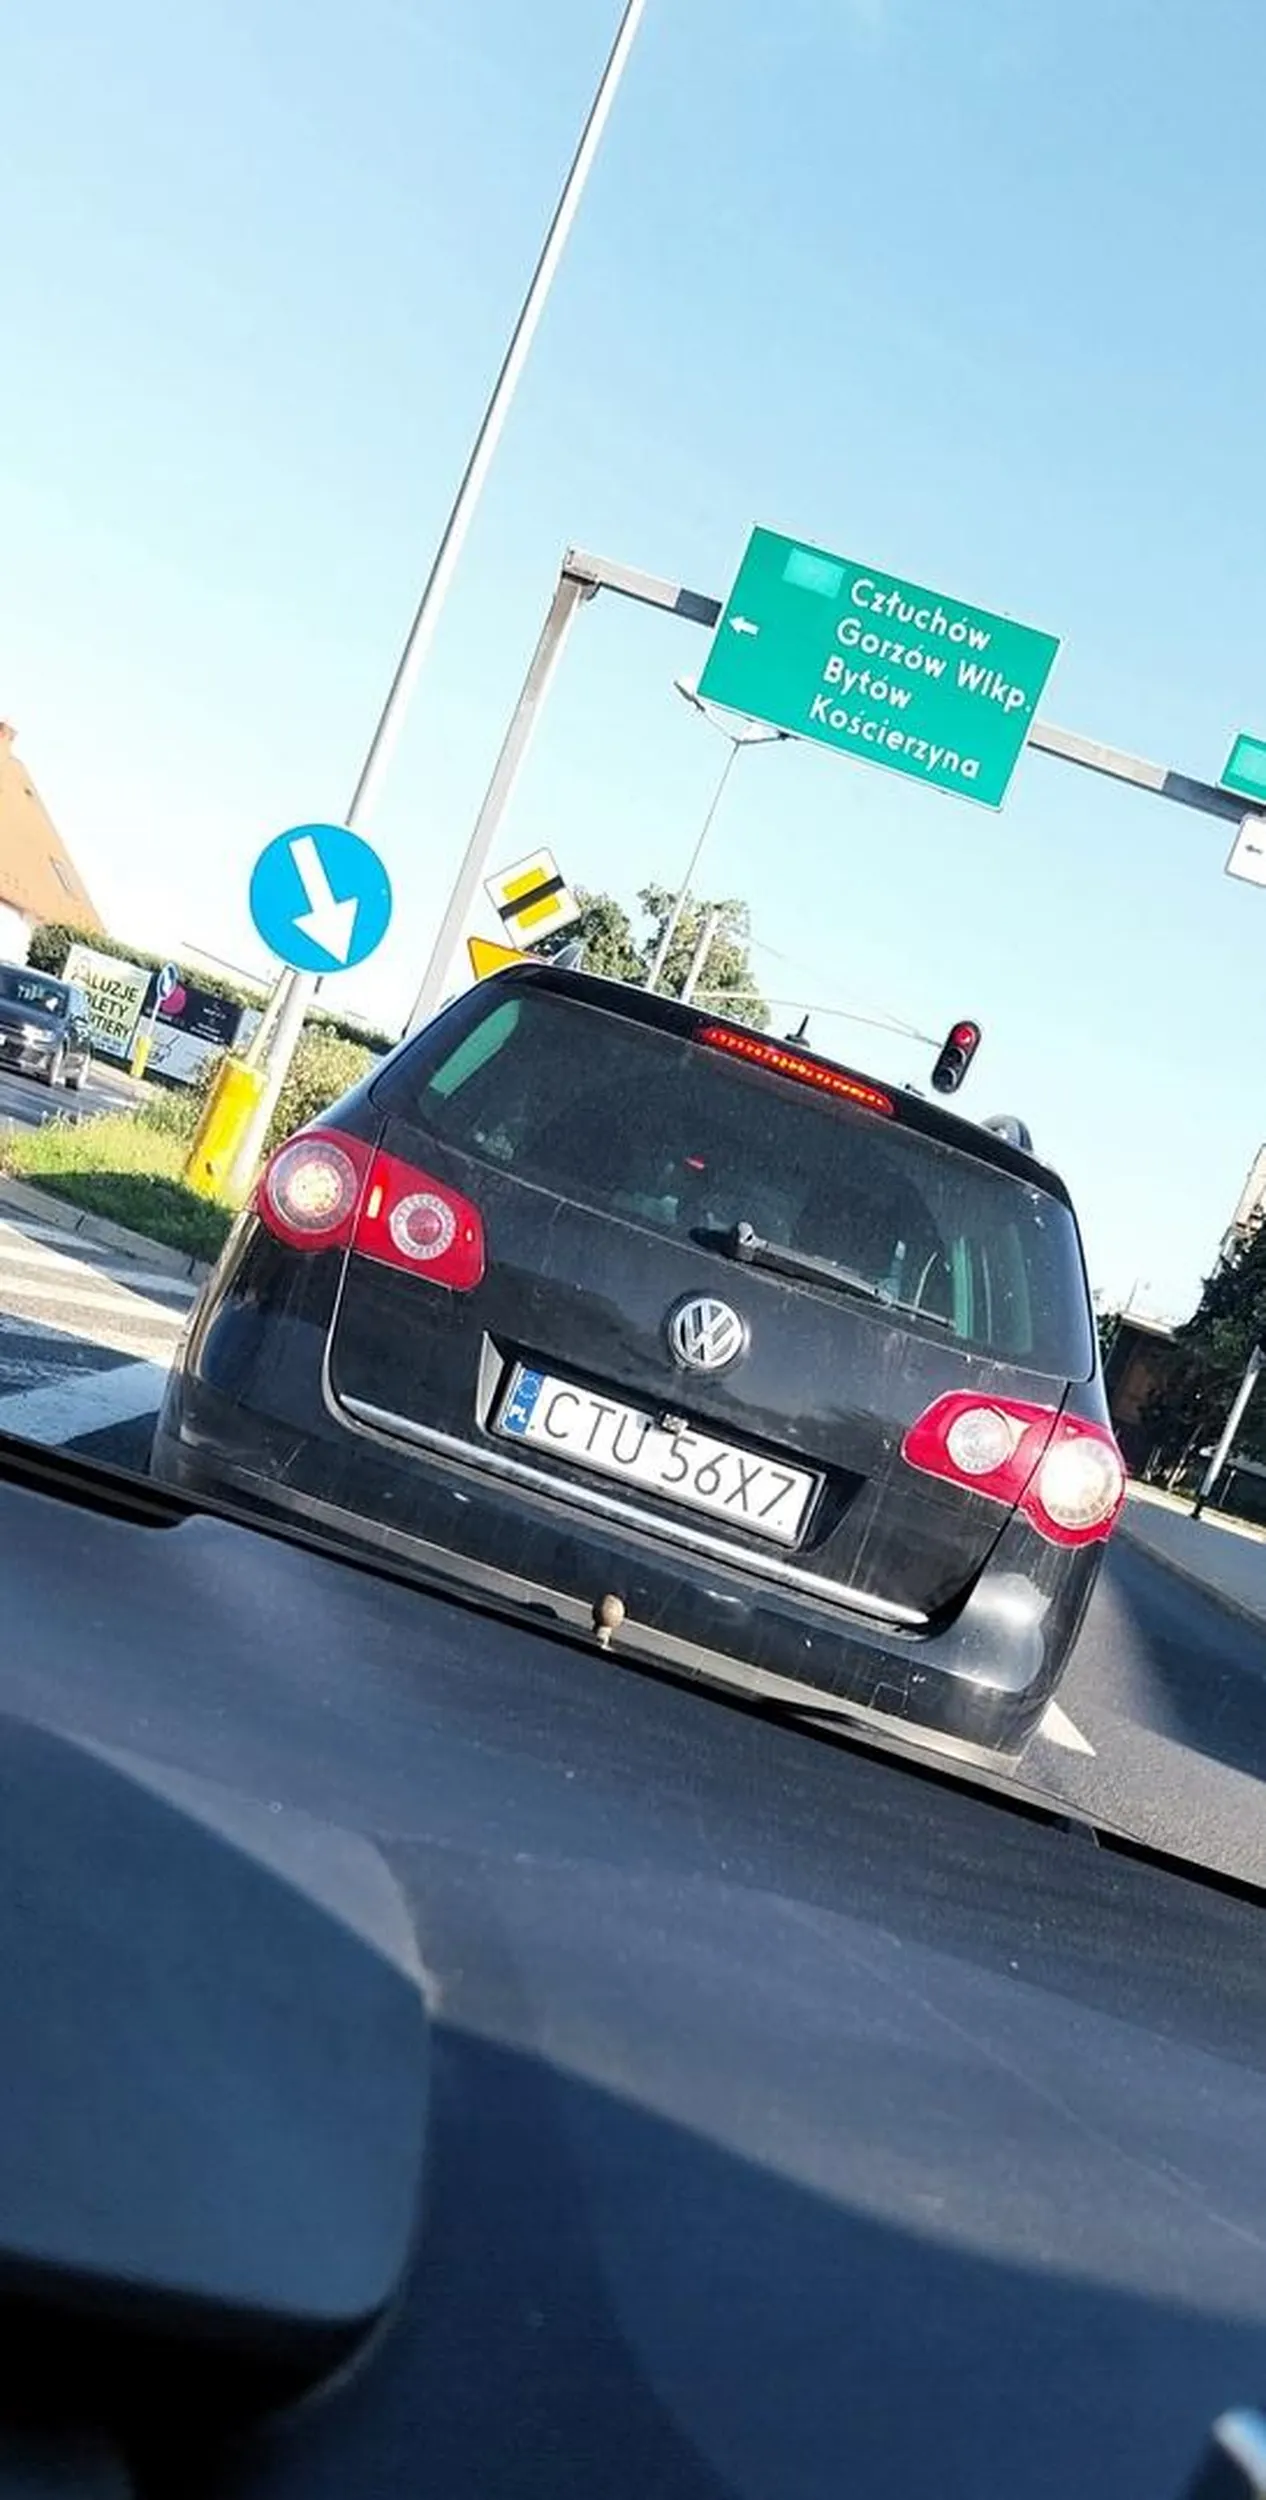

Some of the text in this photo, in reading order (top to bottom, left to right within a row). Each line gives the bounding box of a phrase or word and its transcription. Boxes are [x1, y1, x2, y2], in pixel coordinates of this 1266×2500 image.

[850, 578, 992, 652] Człuchów
[822, 655, 913, 710] Bytów
[835, 618, 1032, 714] Gorzów Wlkp.
[808, 693, 981, 780] Kościerzyna
[543, 1391, 797, 1517] CTU 56X7
